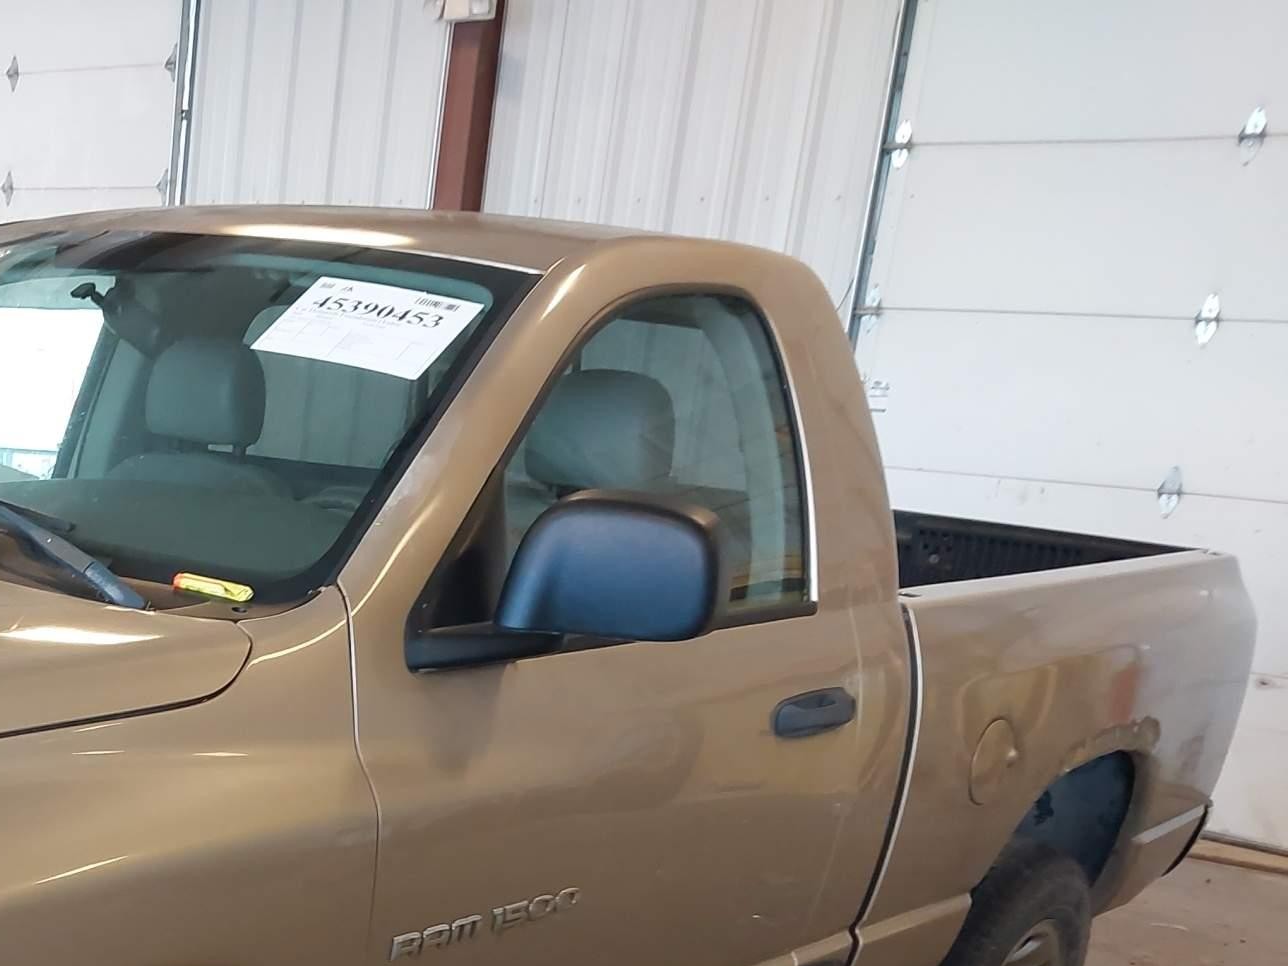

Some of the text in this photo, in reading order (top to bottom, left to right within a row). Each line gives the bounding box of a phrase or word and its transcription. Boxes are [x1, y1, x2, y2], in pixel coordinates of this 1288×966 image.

[312, 296, 444, 328] 45390453
[390, 887, 580, 961] RAM 1500
